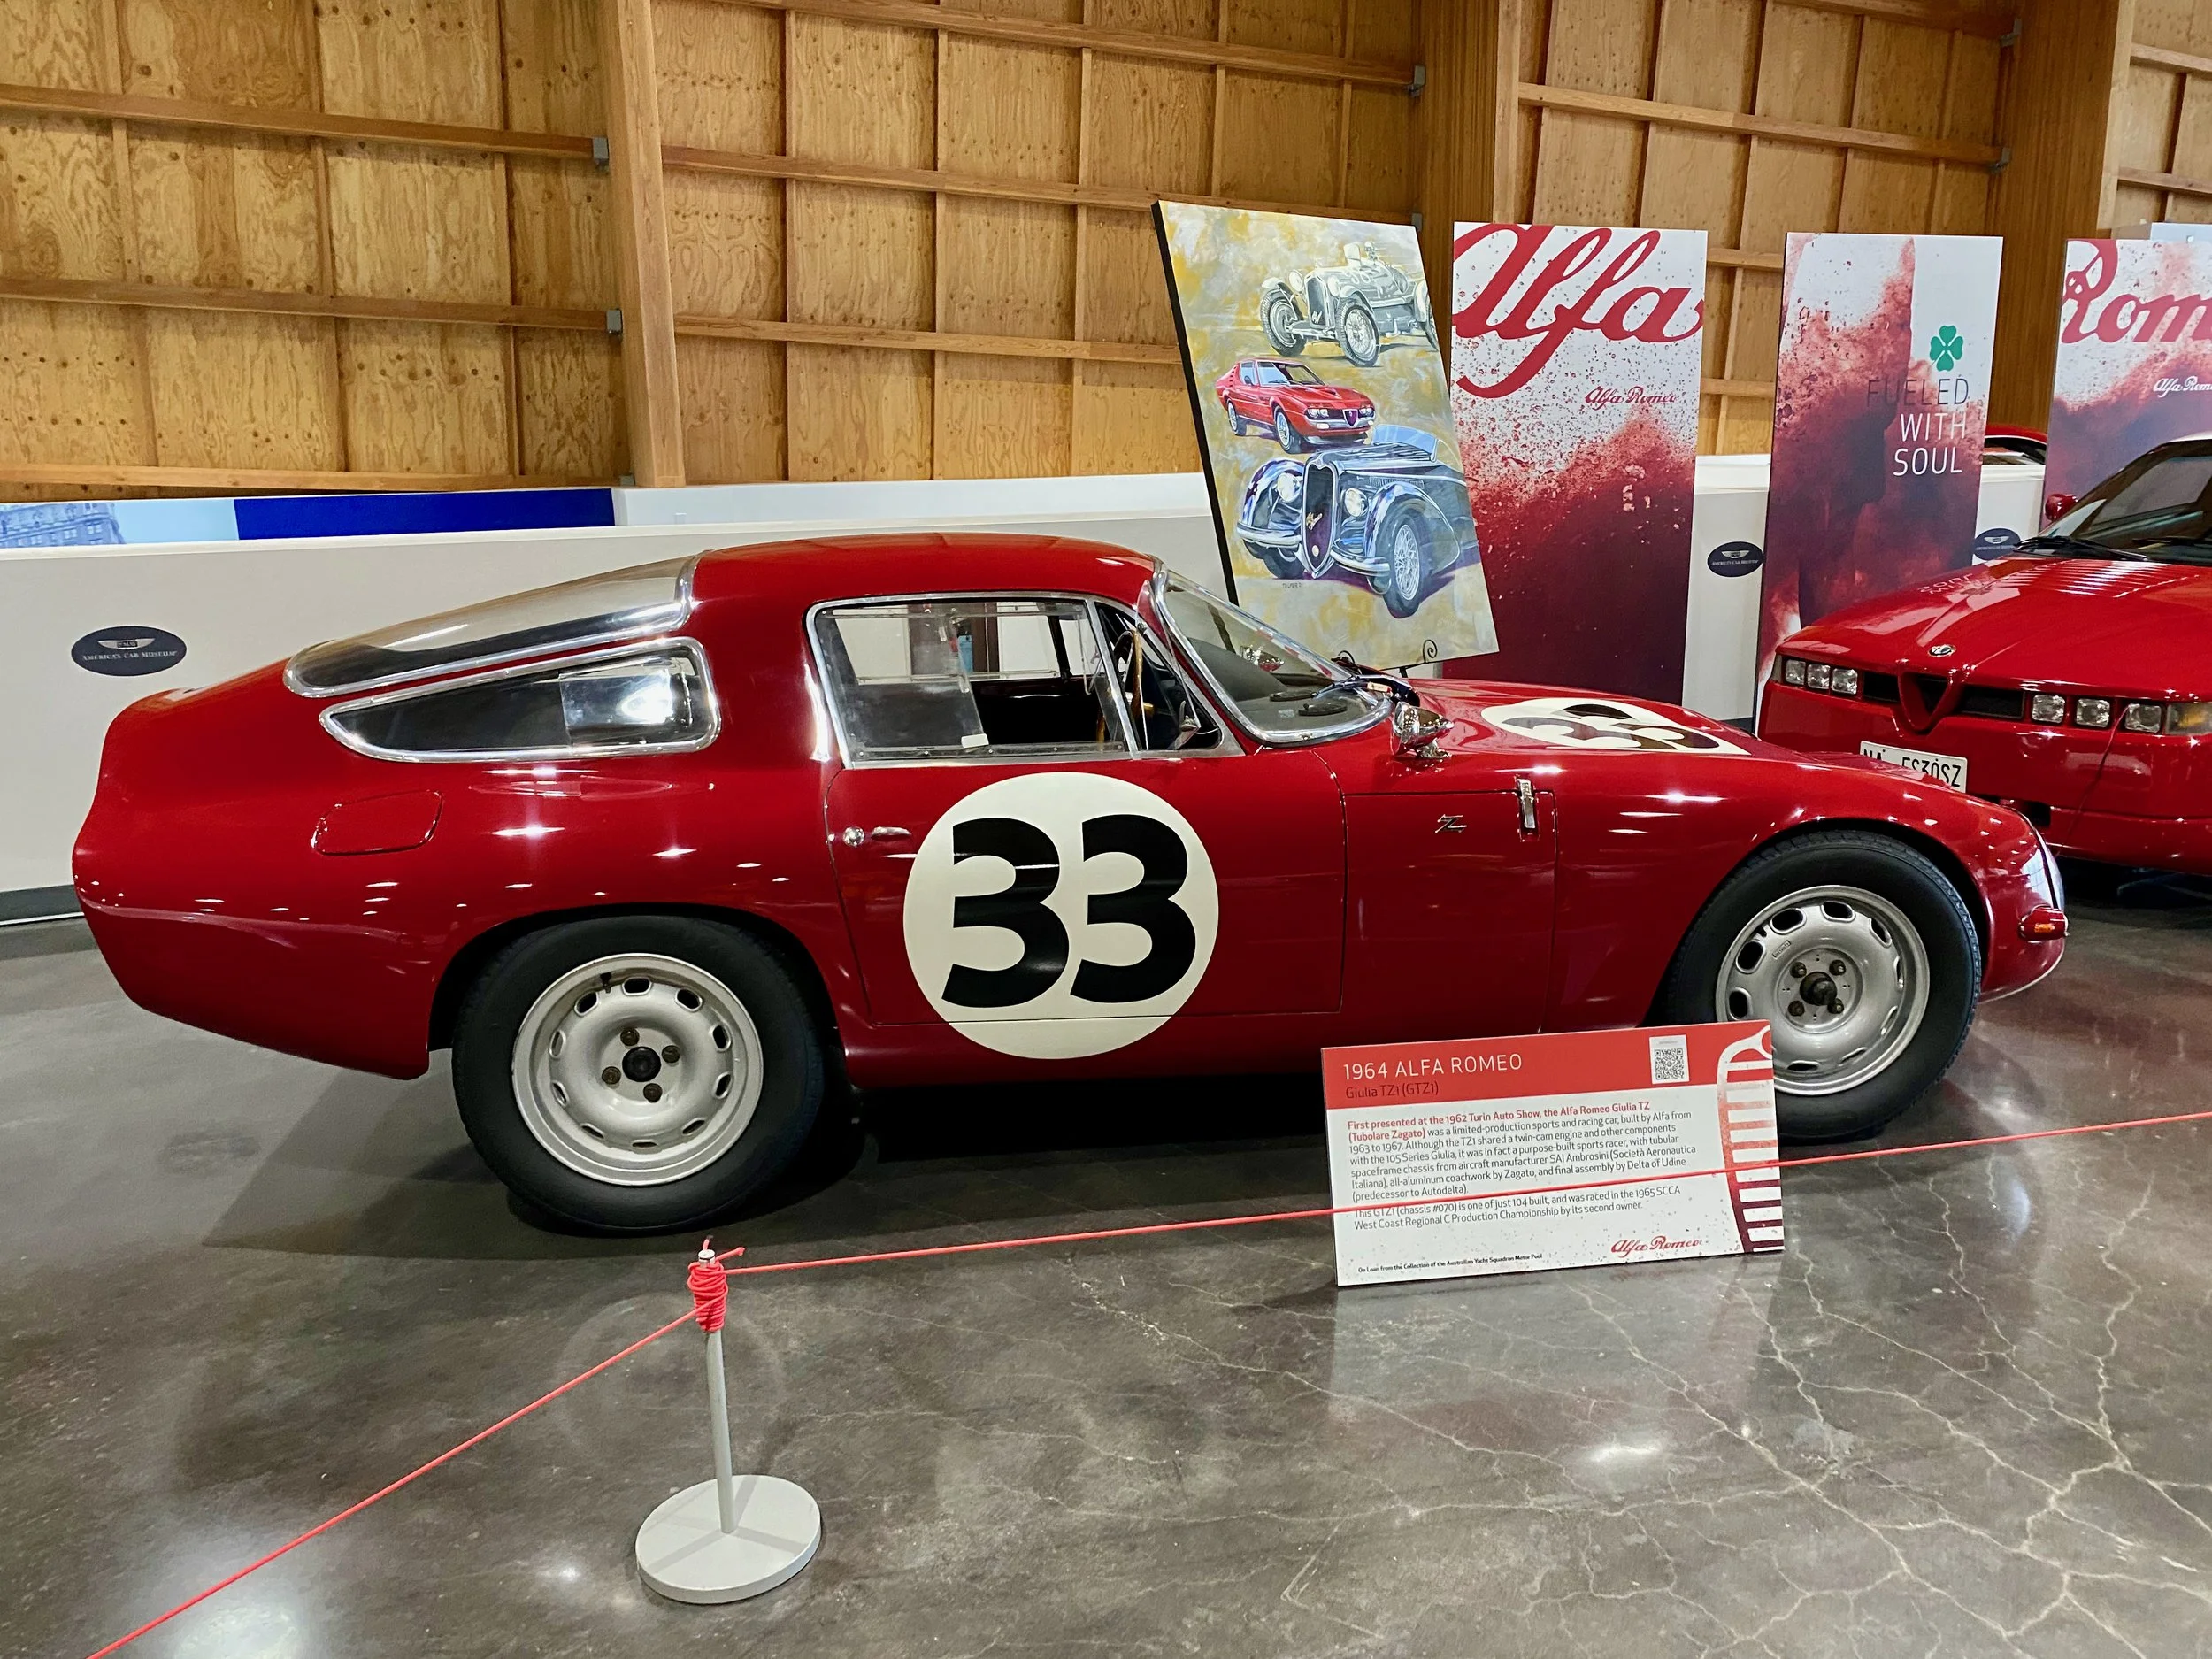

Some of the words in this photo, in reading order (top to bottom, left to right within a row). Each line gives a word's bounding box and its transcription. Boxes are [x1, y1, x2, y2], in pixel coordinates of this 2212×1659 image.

[1452, 223, 1704, 398] Alfa
[1585, 386, 1624, 411] Alfa
[1625, 386, 1677, 403] Romeo
[1866, 378, 1970, 407] FUELED
[2153, 378, 2183, 398] Alfa
[1900, 412, 1966, 442] WITH
[1893, 446, 1962, 476] SOUL
[941, 813, 1196, 1009] 33
[1343, 1061, 1387, 1079] 1964
[1394, 1057, 1444, 1077] ALFA
[1450, 1053, 1521, 1073] ROMEO
[1345, 1087, 1378, 1098] Giulia
[1379, 1084, 1399, 1096] TZ1
[1402, 1080, 1438, 1097] (GTZ1)
[1348, 1120, 1369, 1130] First
[1371, 1117, 1416, 1131] presented
[1417, 1117, 1427, 1125] at
[1428, 1115, 1443, 1124] the
[1445, 1113, 1467, 1124] 1962
[1468, 1112, 1491, 1121] Turin
[1493, 1111, 1514, 1120] Auto
[1516, 1109, 1541, 1118] Show,
[1543, 1108, 1558, 1117] the
[1560, 1106, 1578, 1116] Alfa
[1579, 1105, 1609, 1114] Romeo
[1611, 1102, 1636, 1112] Giulia
[1638, 1101, 1650, 1110] TZ
[1348, 1131, 1389, 1143] (Tubolare
[1391, 1127, 1425, 1141] Zagato)
[1452, 1121, 1531, 1135] limited-production
[1532, 1120, 1559, 1132] sports
[1561, 1118, 1576, 1127] and
[1578, 1117, 1603, 1127] racing
[1620, 1113, 1639, 1123] built
[1640, 1112, 1651, 1124] by
[1652, 1110, 1670, 1121] Alfa
[1671, 1110, 1691, 1119] from
[1349, 1143, 1370, 1155] 1963
[1382, 1141, 1403, 1152] 1967.
[1404, 1138, 1443, 1150] Although
[1445, 1138, 1459, 1147] the
[1460, 1136, 1475, 1146] TZ1
[1477, 1133, 1506, 1145] shared
[1514, 1133, 1553, 1142] twin-cam
[1555, 1129, 1582, 1141] engine
[1583, 1127, 1599, 1137] and
[1600, 1126, 1623, 1136] other
[1624, 1124, 1676, 1135] components
[1349, 1156, 1369, 1164] with
[1370, 1155, 1384, 1164] the
[1386, 1154, 1401, 1164] 105
[1402, 1151, 1429, 1162] Series
[1430, 1149, 1456, 1160] Giulia,
[1458, 1148, 1464, 1157] it
[1484, 1147, 1492, 1156] in
[1494, 1146, 1510, 1156] fact
[1518, 1141, 1575, 1156] purpose-built
[1576, 1140, 1603, 1151] sports
[1604, 1139, 1628, 1148] racer,
[1629, 1136, 1647, 1146] with
[1649, 1133, 1678, 1144] tubular
[1350, 1166, 1402, 1179] spaceframe
[1402, 1163, 1434, 1173] chassis
[1436, 1162, 1456, 1171] from
[1458, 1158, 1489, 1170] aircraft
[1491, 1156, 1548, 1167] manufacturer
[1549, 1153, 1564, 1164] SAI
[1565, 1150, 1609, 1162] Ambrosini
[1609, 1148, 1644, 1160] (Società
[1646, 1145, 1695, 1156] Aeronautica
[1351, 1177, 1388, 1189] Italiana),
[1389, 1175, 1444, 1187] all-aluminum
[1445, 1171, 1491, 1182] coachwork
[1492, 1170, 1502, 1181] by
[1503, 1169, 1536, 1179] Zagato,
[1538, 1165, 1553, 1176] and
[1555, 1164, 1573, 1174] final
[1574, 1162, 1614, 1173] assembly
[1615, 1161, 1625, 1171] by
[1626, 1159, 1649, 1169] Delta
[1651, 1157, 1660, 1167] of
[1661, 1157, 1686, 1166] Udine
[1352, 1190, 1409, 1202] (predecessor
[1421, 1183, 1468, 1196] Autodelta).
[1396, 1205, 1432, 1217] (chassis
[1432, 1202, 1456, 1213] #070)
[1458, 1202, 1465, 1210] is
[1484, 1198, 1493, 1209] of
[1494, 1198, 1511, 1210] just
[1512, 1197, 1527, 1207] 104
[1528, 1194, 1550, 1205] built,
[1551, 1193, 1566, 1203] and
[1586, 1190, 1609, 1201] raced
[1610, 1190, 1618, 1199] in
[1620, 1189, 1633, 1198] the
[1635, 1187, 1655, 1198] 1965
[1655, 1185, 1680, 1195] SCCA
[1354, 1220, 1377, 1230] West
[1378, 1218, 1403, 1228] Coast
[1404, 1214, 1442, 1227] Regional
[1443, 1213, 1450, 1223] C
[1451, 1211, 1498, 1223] Production
[1499, 1206, 1558, 1219] Championship
[1560, 1205, 1570, 1217] by
[1571, 1205, 1583, 1214] its
[1583, 1202, 1614, 1213] second
[1615, 1201, 1642, 1210] owner.
[1611, 1239, 1648, 1258] Alfa
[1649, 1235, 1700, 1250] Romeo
